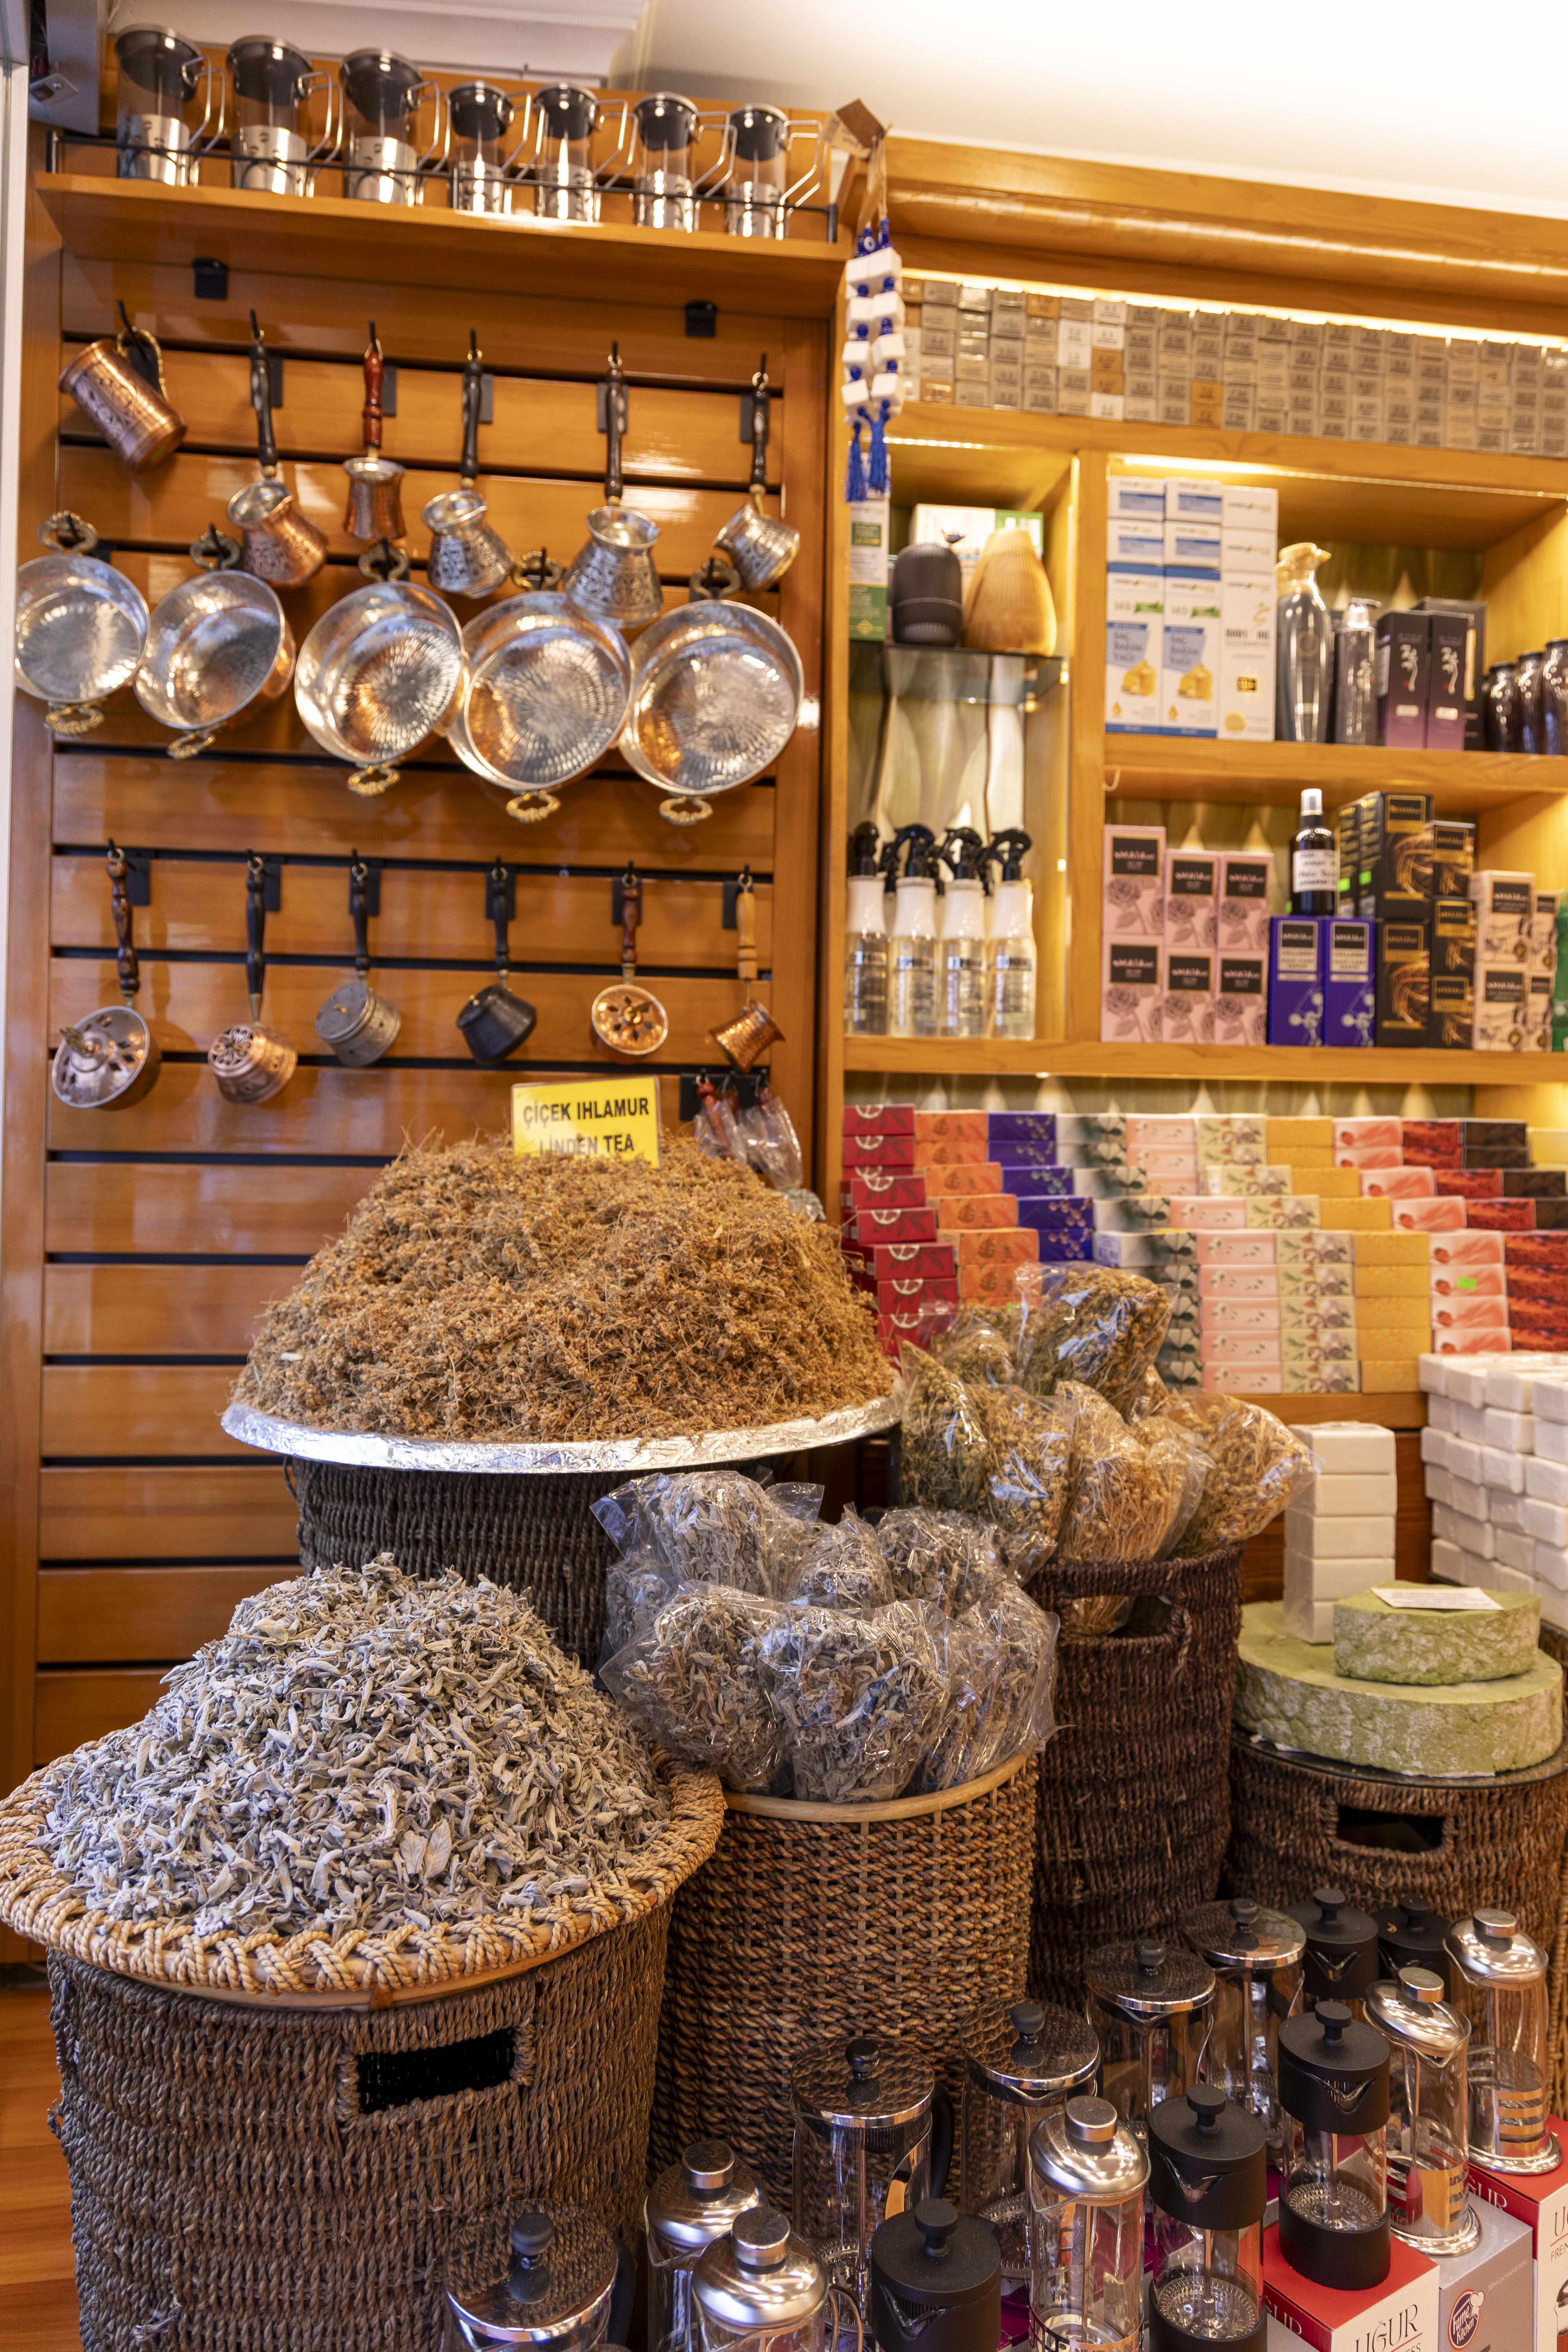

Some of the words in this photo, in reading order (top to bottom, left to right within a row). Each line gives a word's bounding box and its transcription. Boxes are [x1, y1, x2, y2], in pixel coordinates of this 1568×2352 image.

[524, 1100, 571, 1129] ÇİÇEK
[577, 1098, 649, 1120] IHLAMUR
[603, 1134, 634, 1153] TEA
